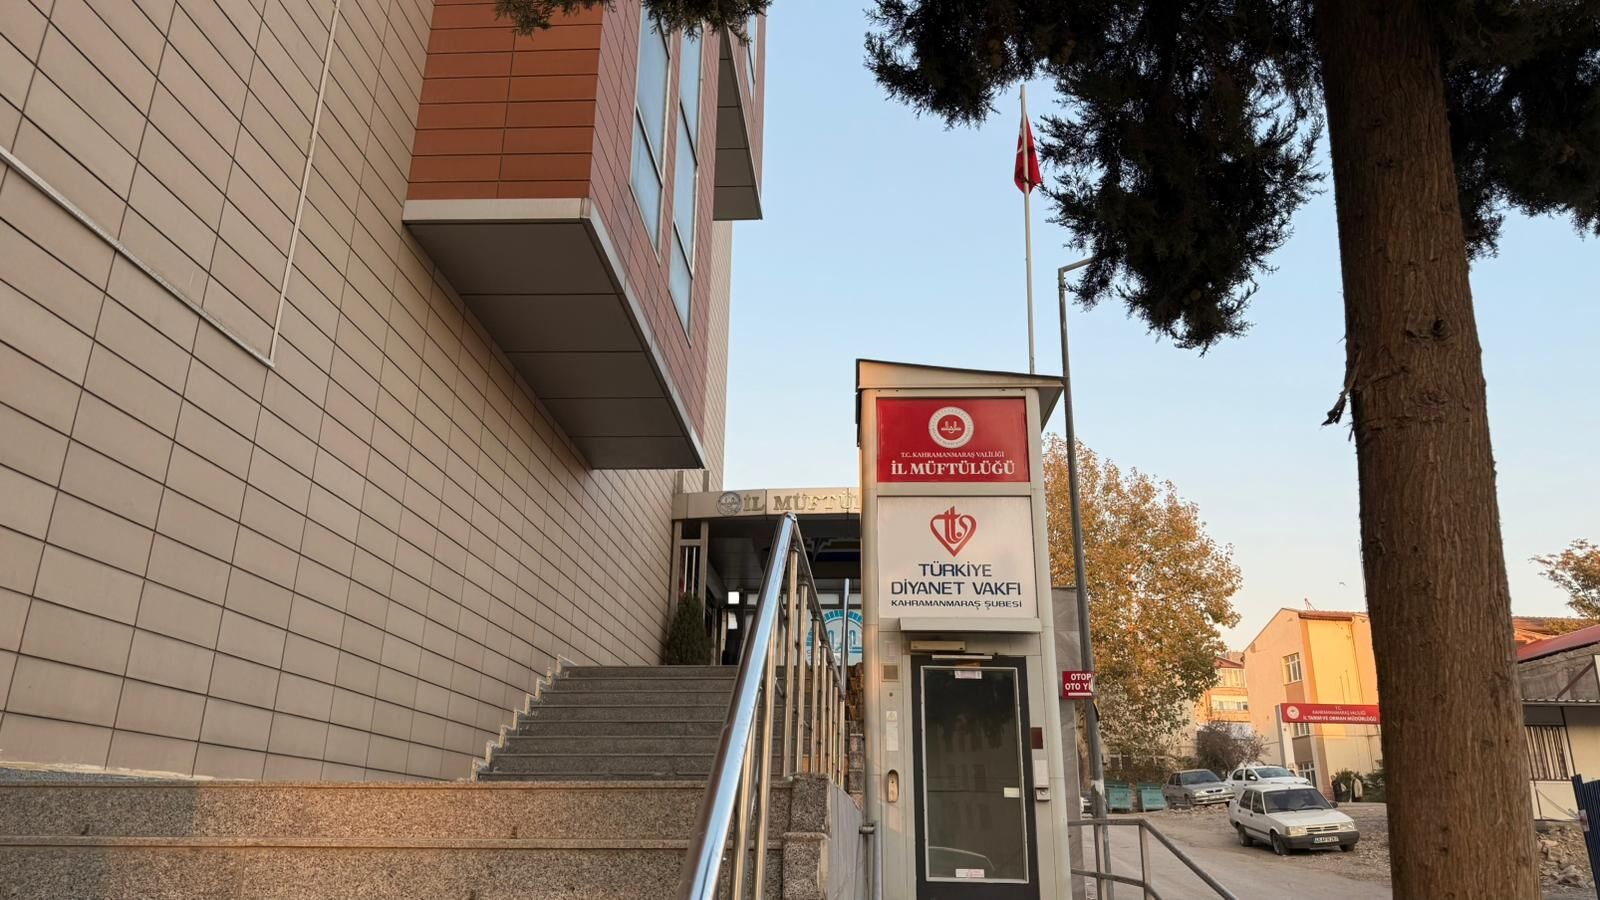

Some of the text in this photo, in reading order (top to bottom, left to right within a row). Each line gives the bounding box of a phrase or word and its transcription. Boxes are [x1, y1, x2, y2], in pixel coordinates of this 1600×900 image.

[976, 450, 1005, 458] VALİLİĞİ
[891, 460, 1015, 475] İL MÜFTÜLÜĞÜ
[743, 493, 765, 511] İL
[919, 561, 992, 577] TÜRKİYE
[891, 579, 1021, 596] DİYANET VAKFI
[891, 599, 1022, 611] KAHRAMANMARAŞ ŞUBESİ
